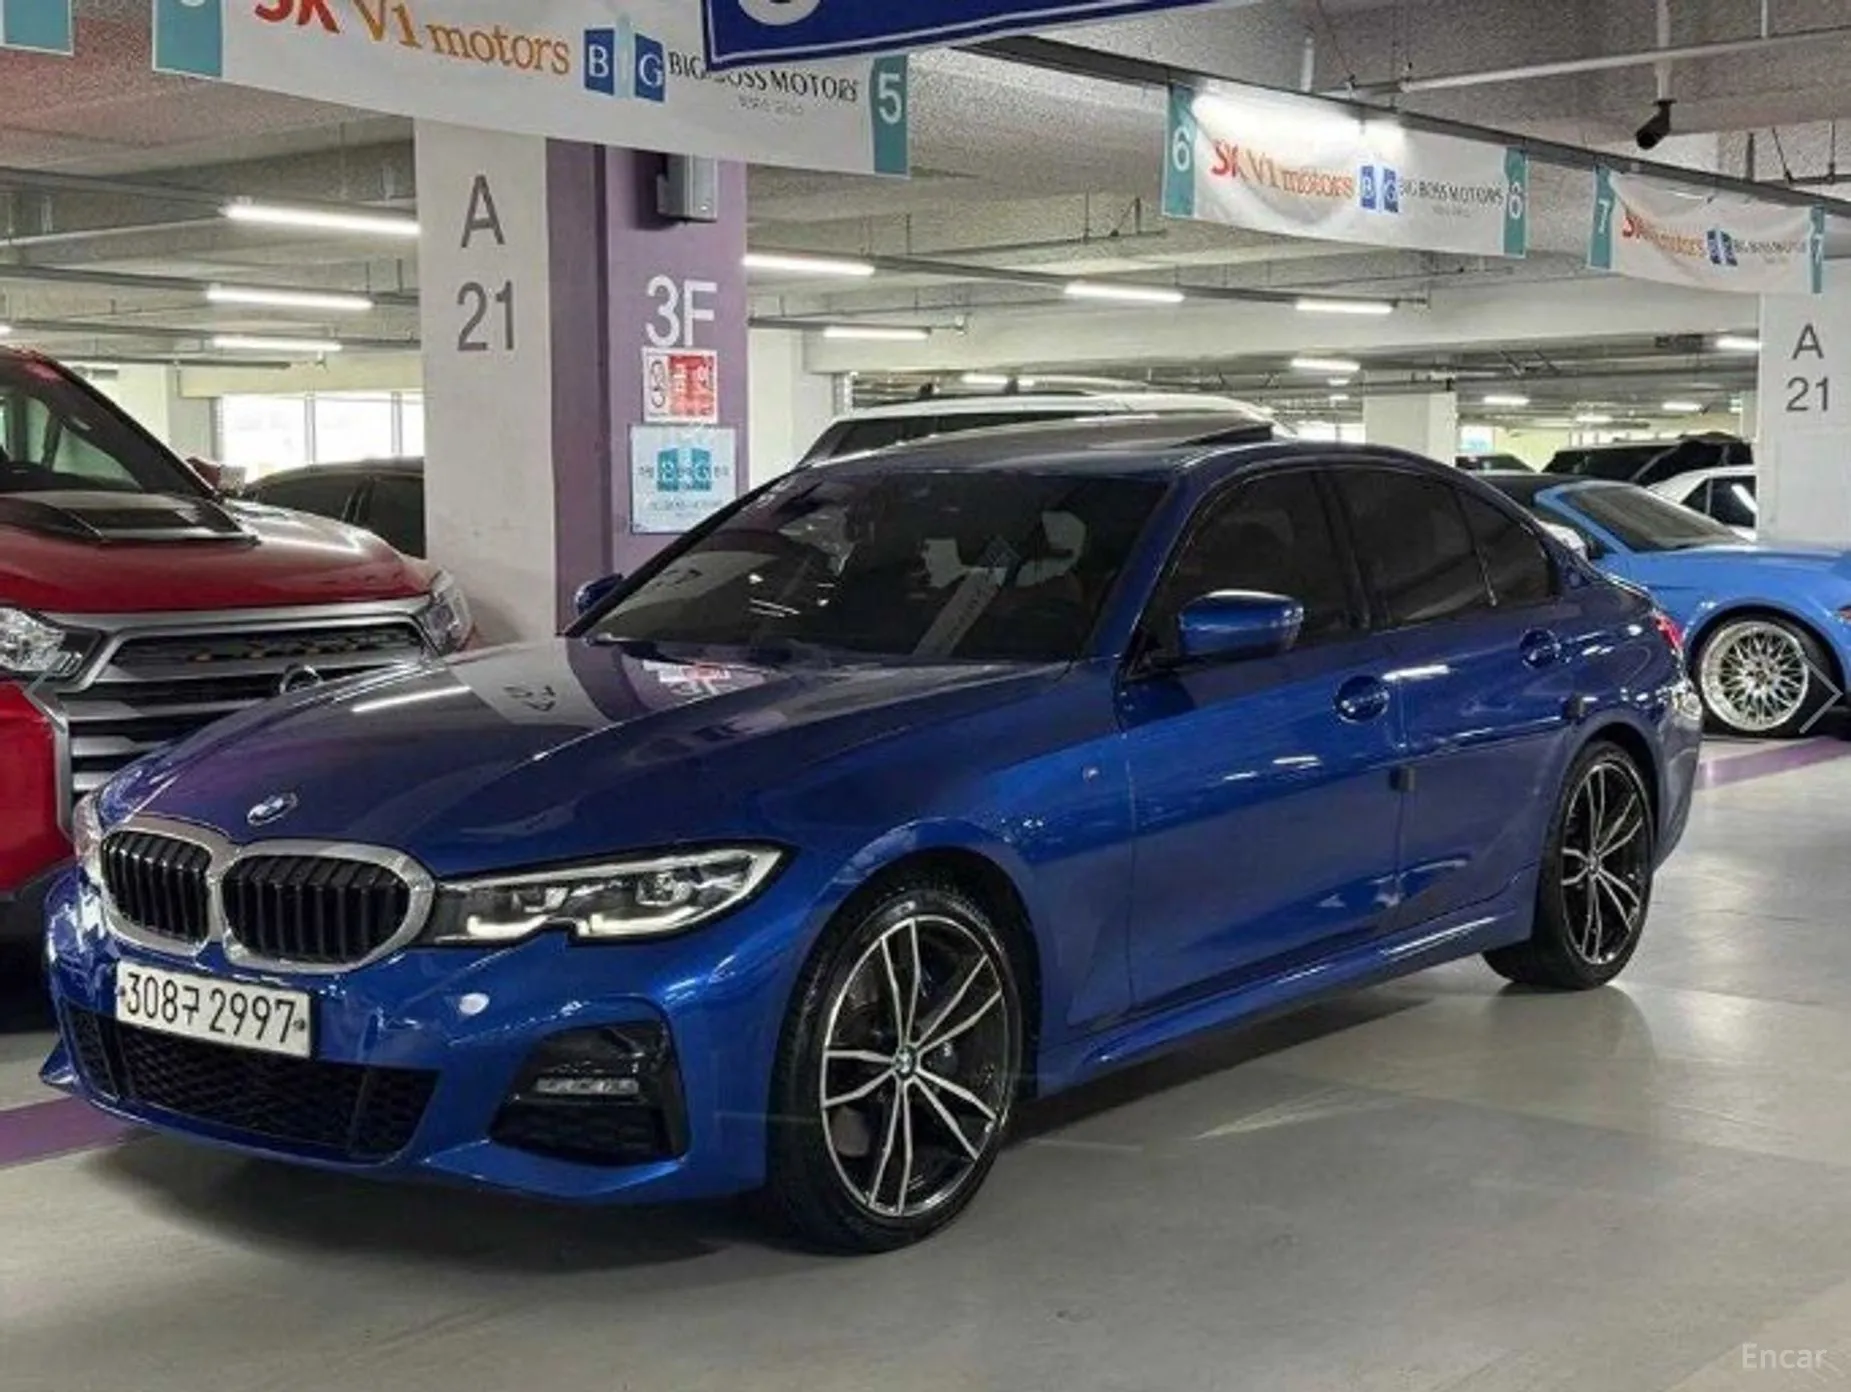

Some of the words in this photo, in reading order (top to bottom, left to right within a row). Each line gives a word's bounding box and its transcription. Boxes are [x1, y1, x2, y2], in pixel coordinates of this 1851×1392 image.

[426, 24, 571, 76] motors
[588, 44, 610, 78] B
[639, 52, 664, 87] G
[713, 69, 767, 91] OSS
[769, 69, 861, 103] MOTORS
[878, 72, 901, 125] 5
[1172, 125, 1190, 172] 6
[1281, 167, 1356, 200] motors
[1448, 184, 1506, 206] MOTORS
[1508, 181, 1523, 219] 6
[460, 174, 505, 249] A
[1597, 199, 1609, 235] 7
[456, 279, 515, 352] 21
[645, 274, 718, 347] 3F
[1791, 322, 1825, 361] A
[1785, 375, 1830, 413] 21
[127, 971, 199, 1026] 308구
[208, 987, 297, 1044] 2997
